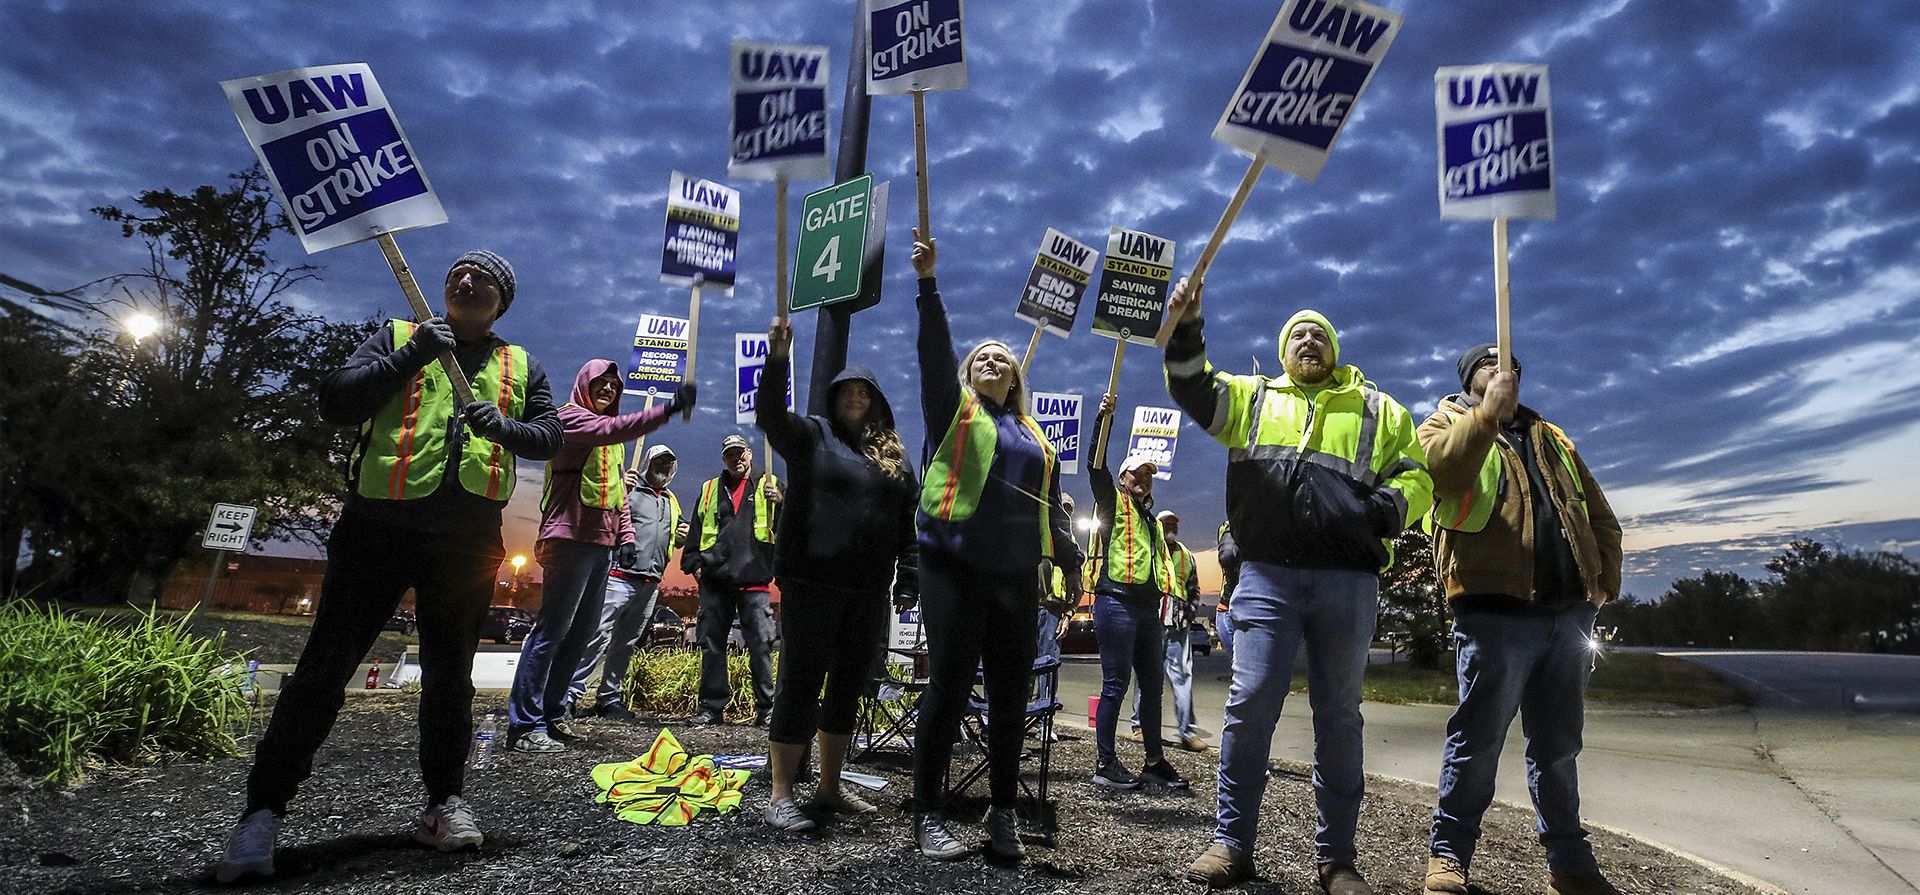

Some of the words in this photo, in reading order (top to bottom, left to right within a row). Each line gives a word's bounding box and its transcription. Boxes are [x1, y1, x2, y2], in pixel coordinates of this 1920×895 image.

[896, 0, 929, 37] ON
[1289, 0, 1391, 55] UAW
[872, 19, 960, 78] STRIKE
[741, 50, 822, 80] UAW
[1280, 56, 1335, 90] ON
[242, 73, 368, 124] UAW
[1449, 73, 1540, 108] UAW
[760, 88, 796, 122] ON
[1230, 90, 1354, 127] STRIKE
[306, 123, 361, 171] ON
[733, 111, 825, 160] STRIKE
[1471, 114, 1513, 158] ON
[1444, 138, 1549, 196] STRIKE
[292, 140, 414, 229] STRIKE
[682, 178, 729, 210] UAW
[806, 192, 865, 232] GATE
[678, 224, 726, 246] SAVING
[1119, 231, 1165, 262] UAW
[666, 236, 734, 262] AMERICAN
[677, 251, 723, 271] DREAM
[812, 235, 841, 283] 4
[1051, 235, 1090, 267] UAW
[1040, 256, 1072, 276] STAND
[1073, 270, 1086, 281] UP
[1108, 260, 1148, 275] STAND
[1151, 268, 1167, 278] UP
[1038, 273, 1076, 298] END
[1112, 279, 1156, 295] SAVING
[1028, 285, 1077, 316] TIERS
[1100, 292, 1162, 312] AMERICAN
[1108, 305, 1151, 320] DREAM
[647, 318, 687, 337] UAW
[637, 339, 671, 348] STAND
[641, 351, 679, 360] RECORD
[742, 340, 768, 357] UA
[638, 365, 675, 375] RECORD
[640, 358, 678, 367] PROFITS
[629, 373, 682, 382] CONTRACTS
[1037, 398, 1078, 416] UAW
[1142, 411, 1173, 425] UAW
[1045, 421, 1064, 440] ON
[1137, 437, 1168, 450] END
[217, 510, 249, 520] KEEP
[208, 532, 244, 544] RIGHT
